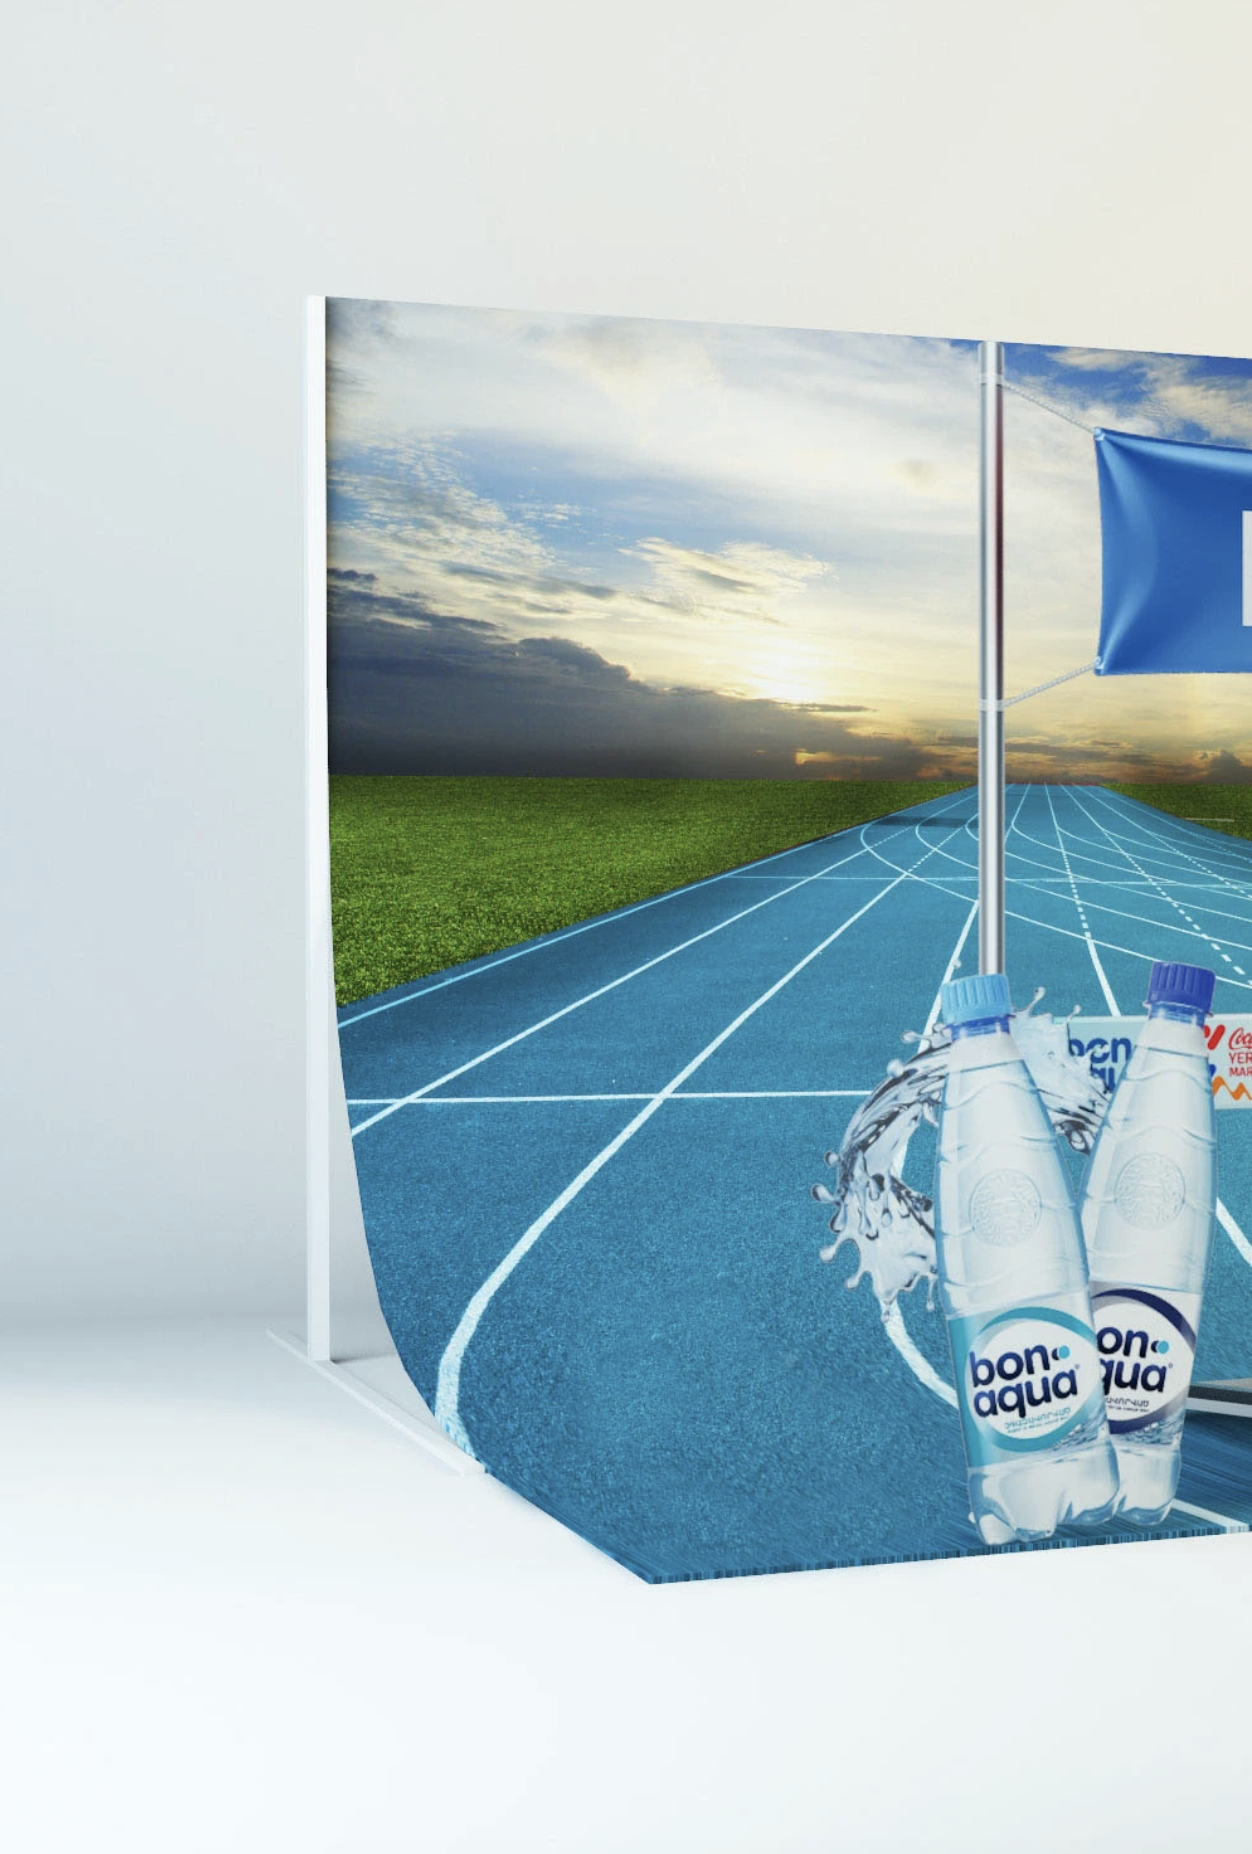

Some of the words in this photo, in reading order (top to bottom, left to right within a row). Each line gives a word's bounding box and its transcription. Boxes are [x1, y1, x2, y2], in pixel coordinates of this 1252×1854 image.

[969, 1344, 1051, 1388] bon
[1099, 1358, 1168, 1396] qua
[974, 1369, 1078, 1418] aqua
